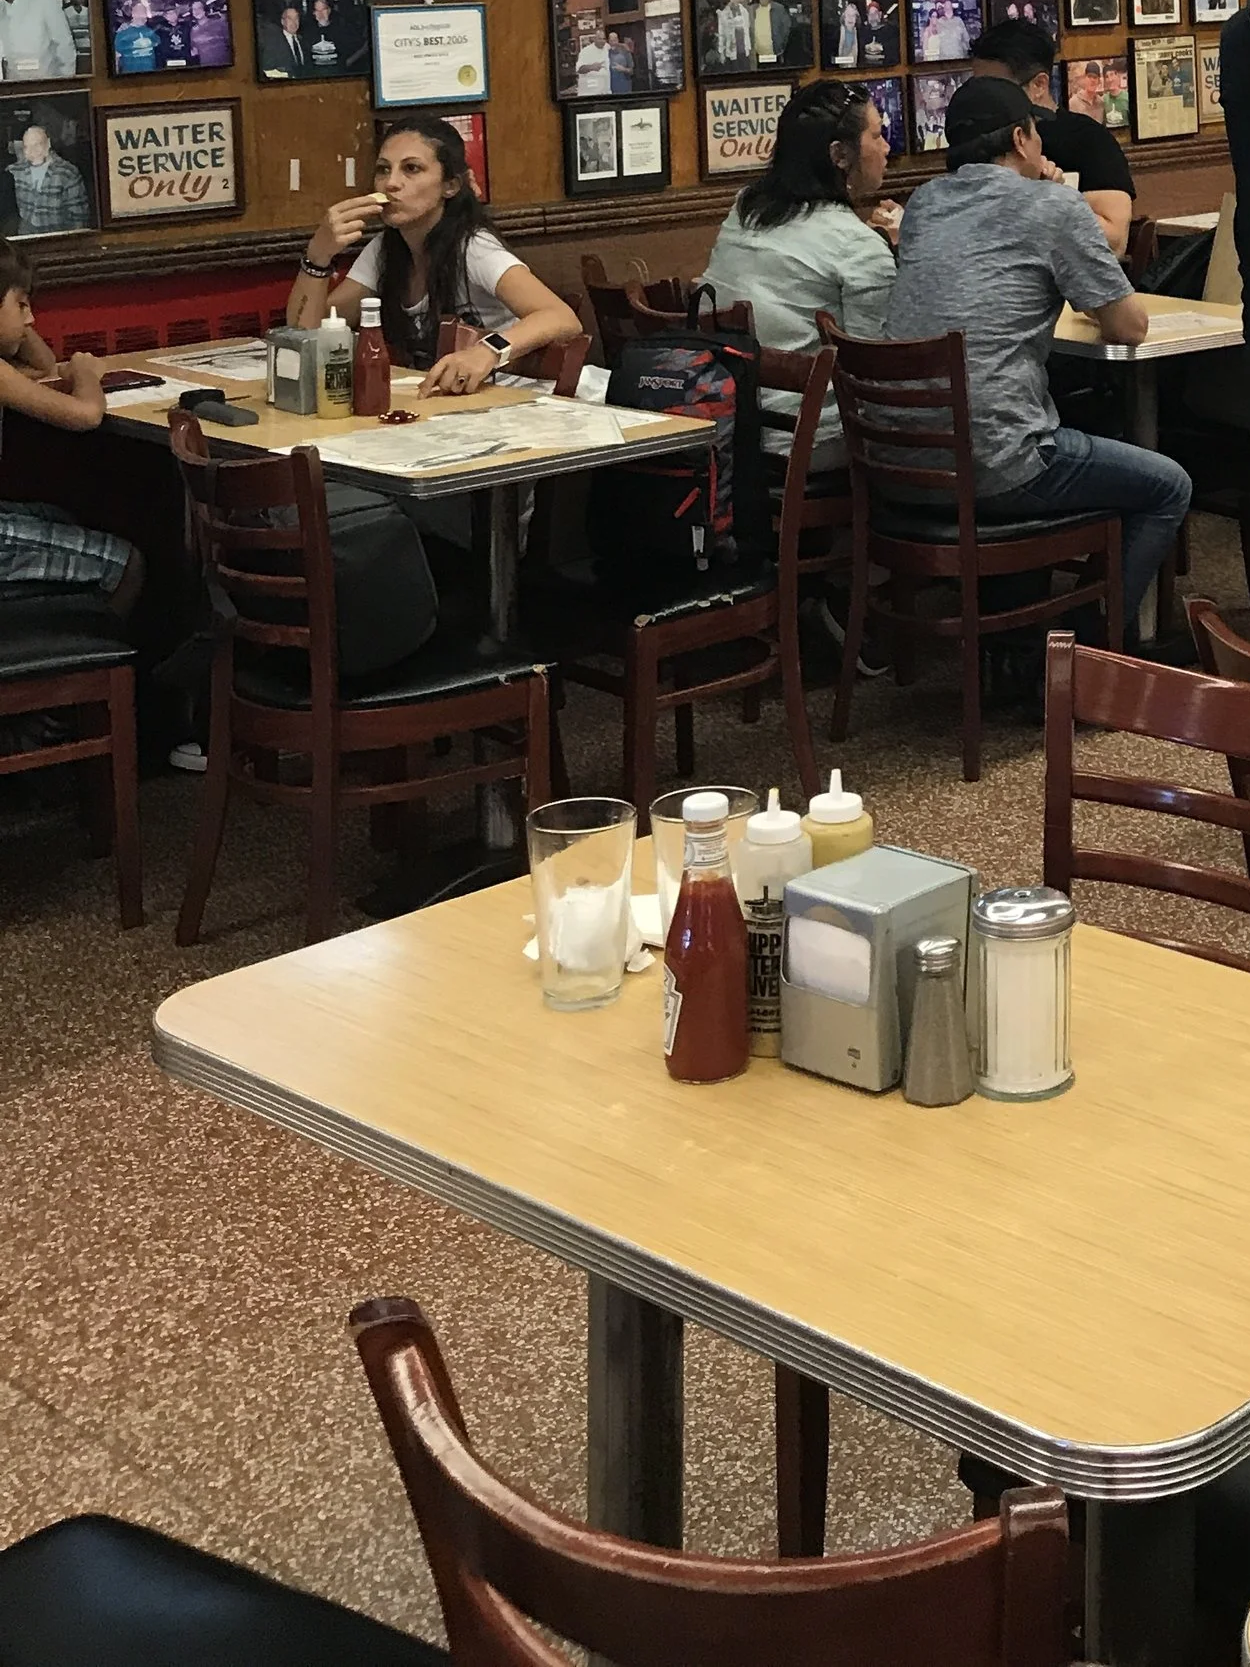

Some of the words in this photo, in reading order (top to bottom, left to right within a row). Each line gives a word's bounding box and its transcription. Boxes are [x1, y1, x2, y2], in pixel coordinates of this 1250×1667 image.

[394, 37, 422, 48] CITY'S
[423, 36, 444, 47] BEST
[710, 94, 787, 118] WAITER
[113, 121, 227, 151] WAITER
[712, 117, 777, 140] SERVIC
[719, 135, 774, 162] Only
[117, 146, 227, 178] SERVICE
[127, 171, 213, 203] Only
[221, 178, 230, 190] 2
